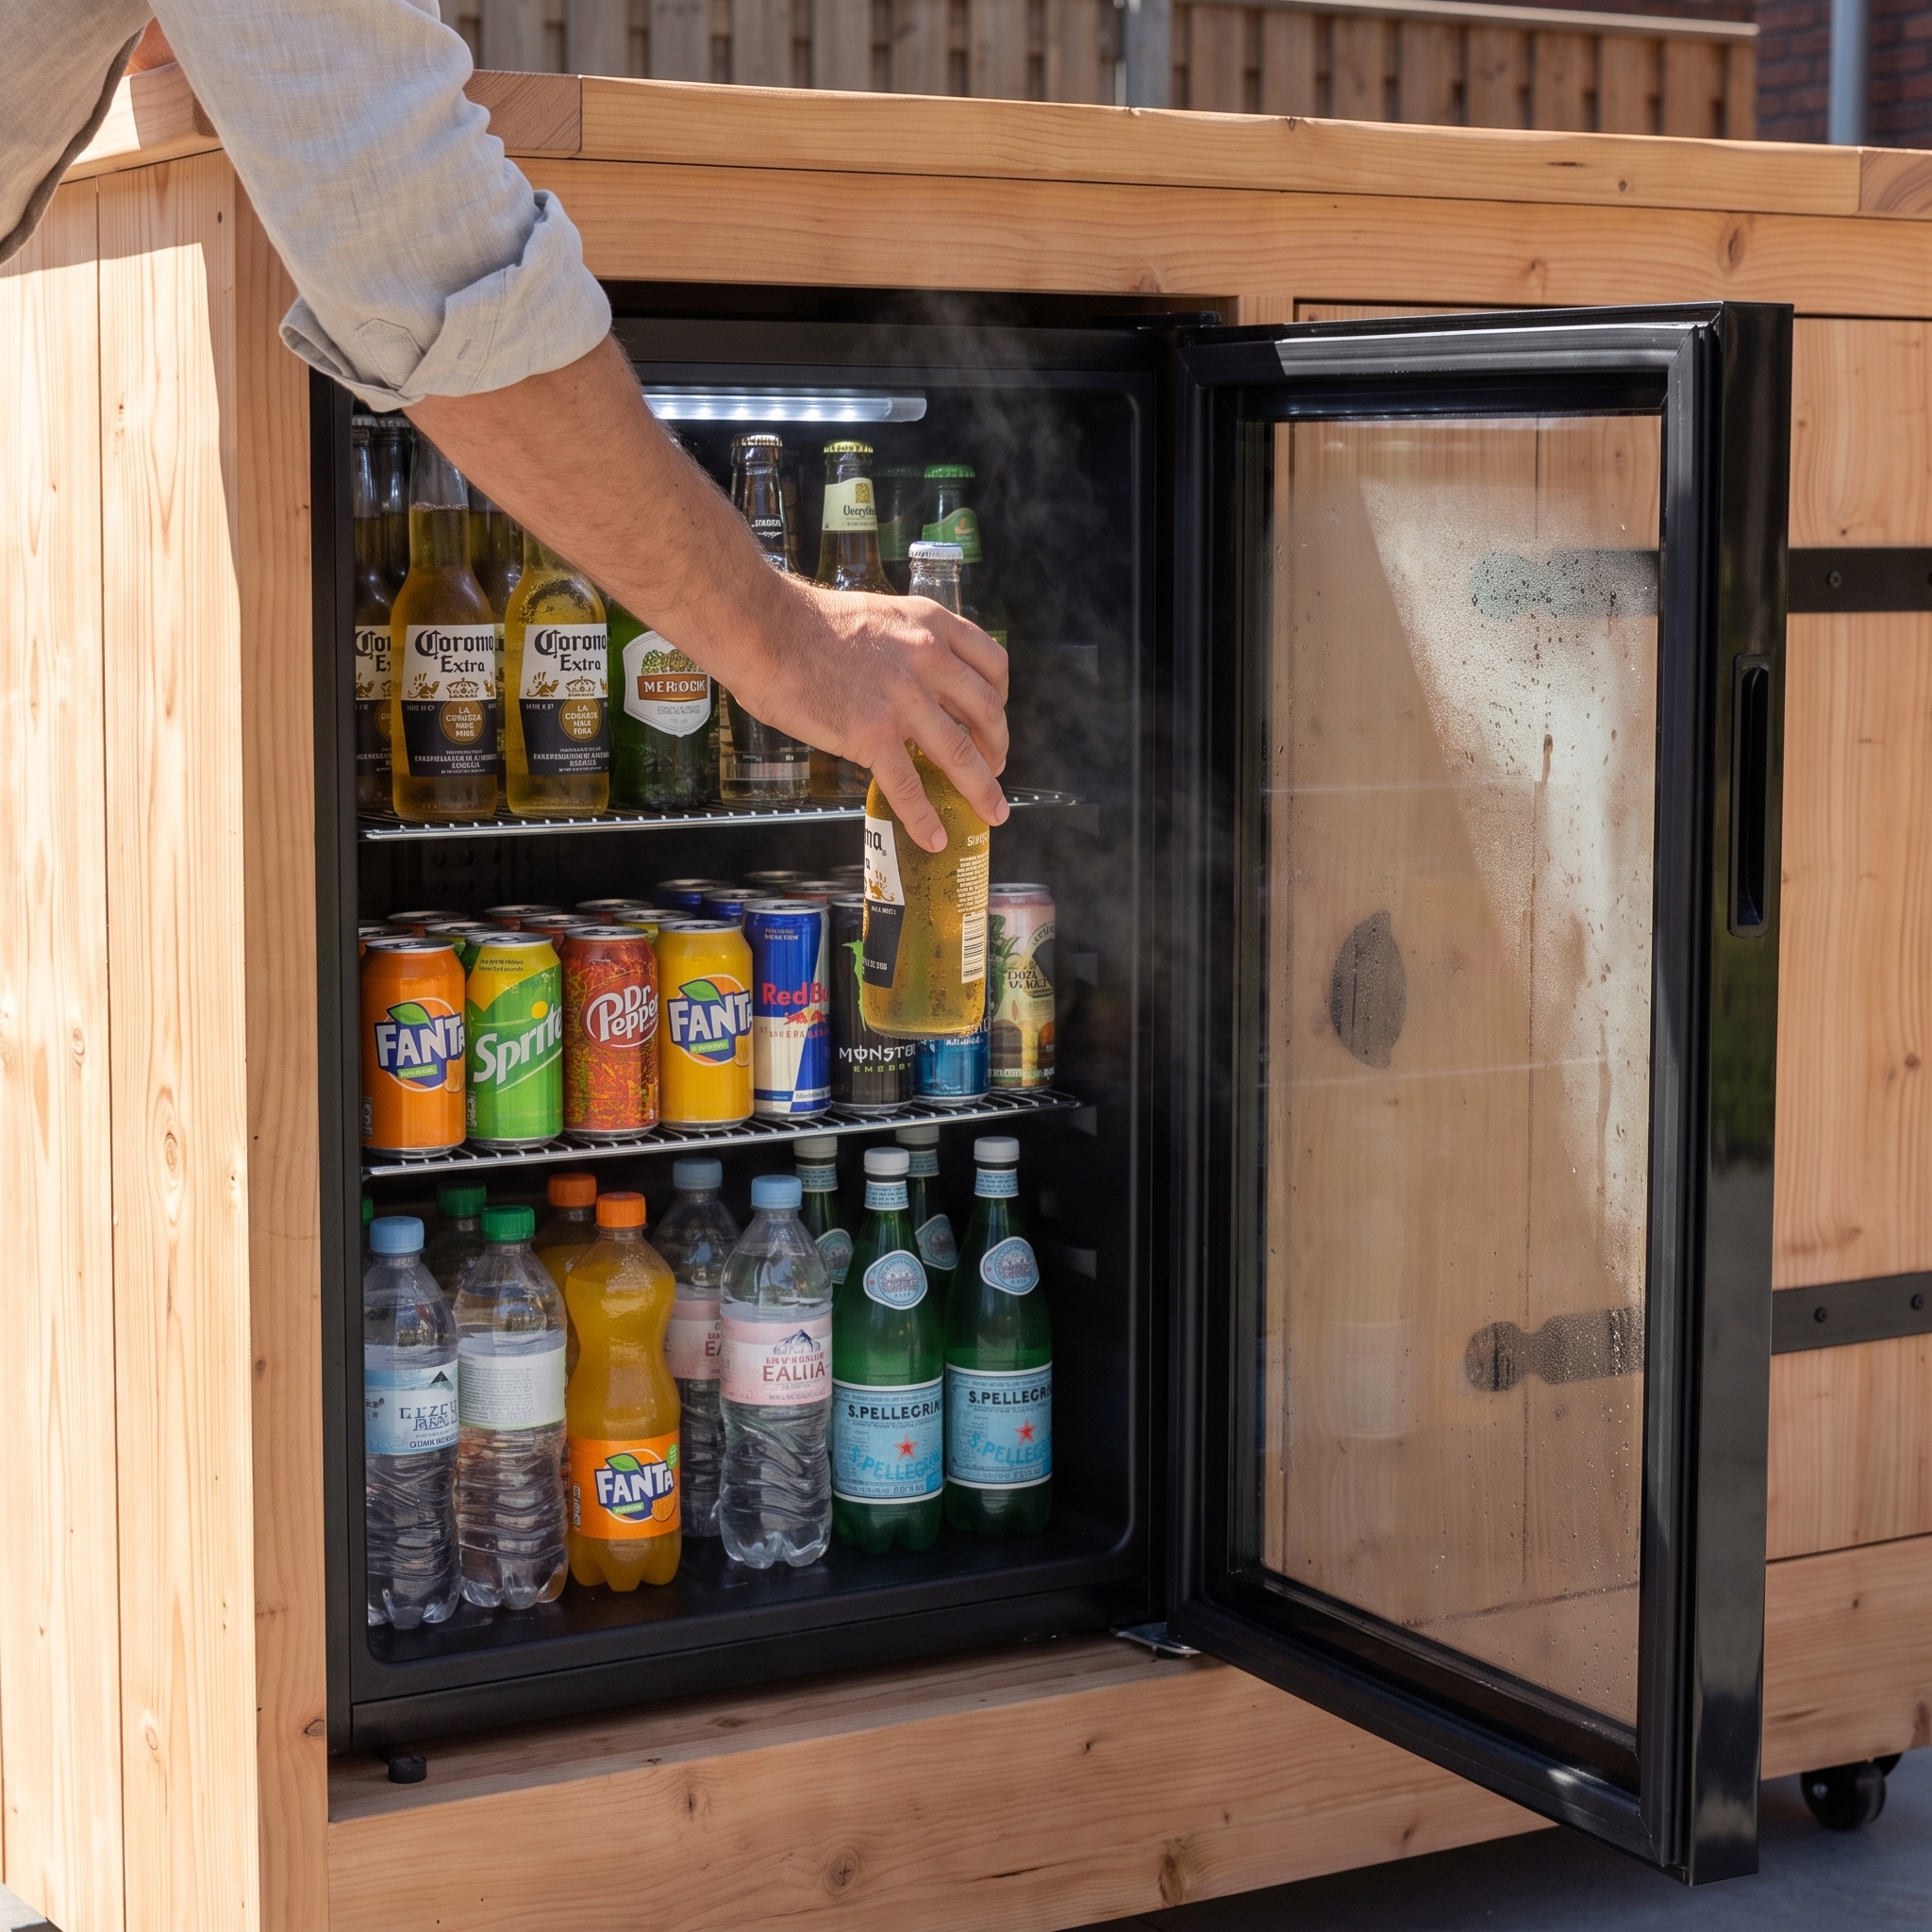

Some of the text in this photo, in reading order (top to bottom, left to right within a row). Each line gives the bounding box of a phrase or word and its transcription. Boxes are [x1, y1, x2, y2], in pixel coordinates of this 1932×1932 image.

[441, 655, 485, 673] Extra
[559, 654, 601, 672] Extra
[623, 985, 652, 1015] Dr
[762, 982, 808, 1006] Red
[376, 1015, 465, 1067] FANTA
[595, 1462, 675, 1505] FANTA
